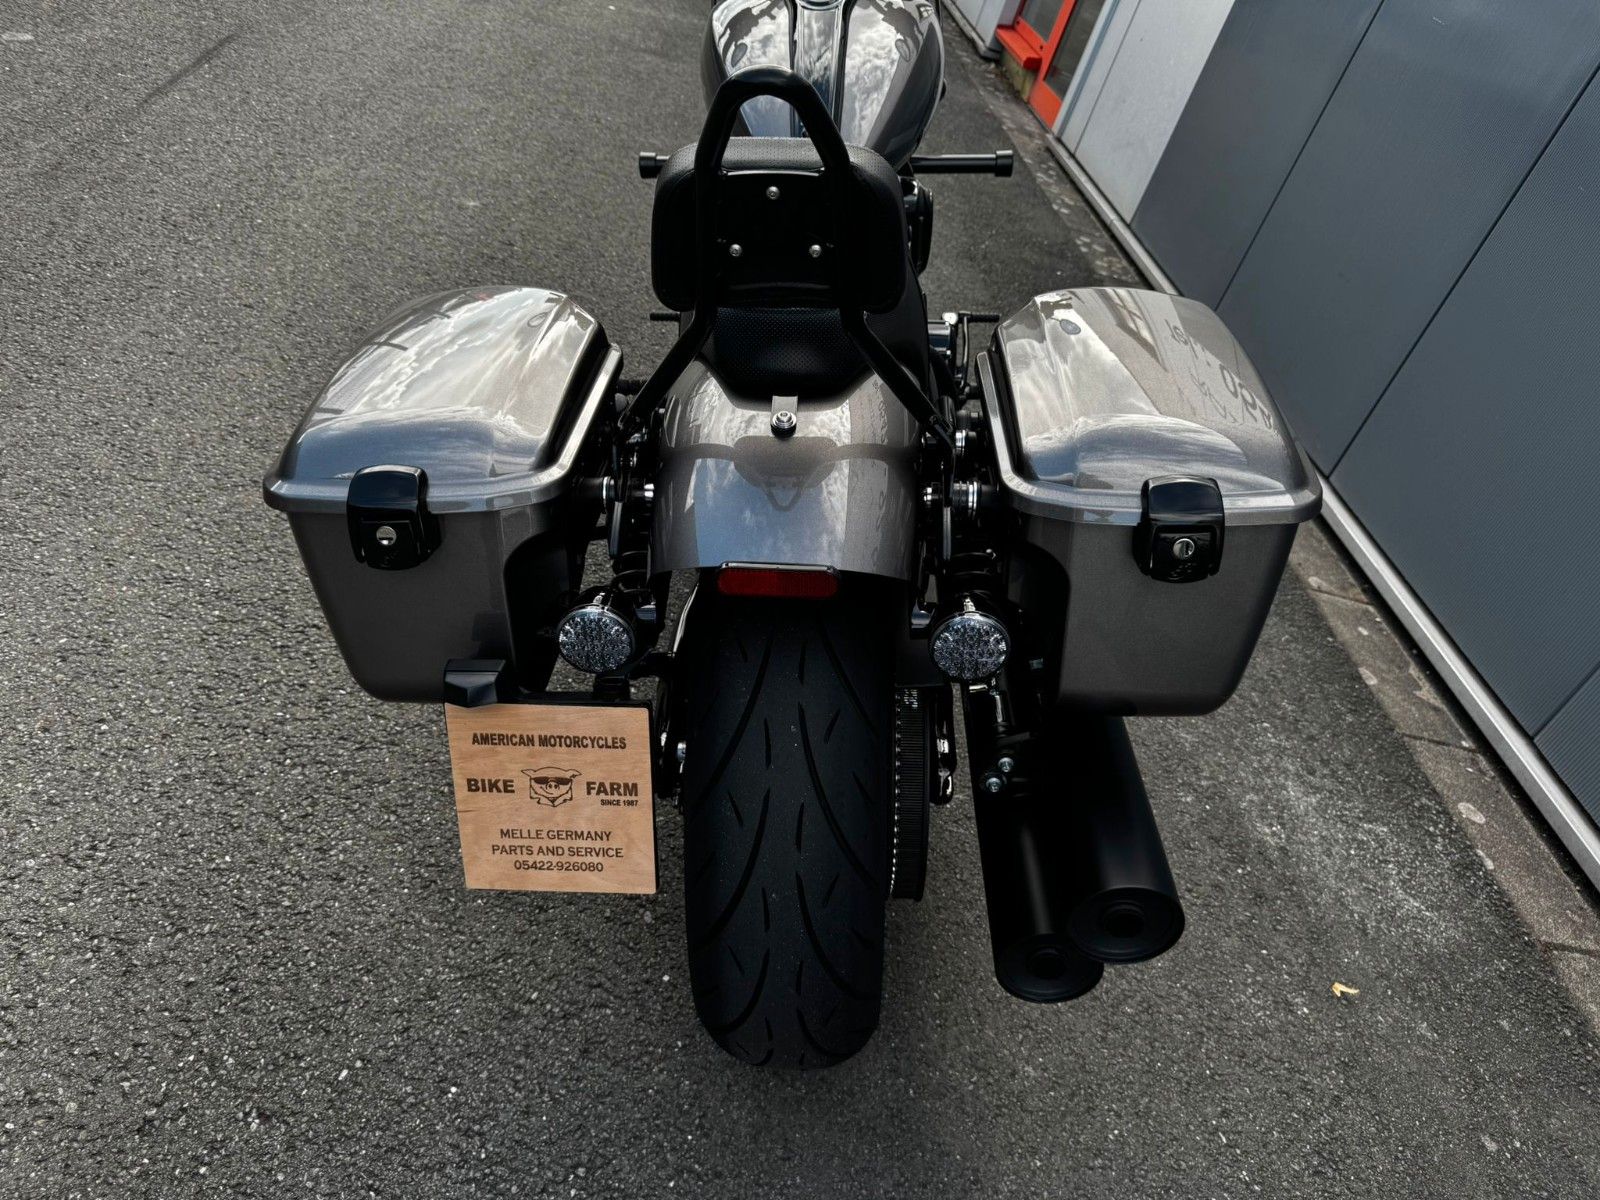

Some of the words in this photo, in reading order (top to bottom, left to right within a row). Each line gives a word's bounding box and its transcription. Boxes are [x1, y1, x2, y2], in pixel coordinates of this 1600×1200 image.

[472, 733, 535, 747] AMERICAN
[539, 735, 626, 749] MOTORCYCLES
[466, 778, 515, 793] BIKE
[586, 781, 638, 796] FARM
[500, 829, 544, 839] MELLE
[547, 830, 612, 841] GERMANY
[492, 845, 533, 855] PARTS
[537, 846, 565, 856] AND
[568, 846, 623, 858] SERVICE
[514, 860, 604, 872] 05422-926080
